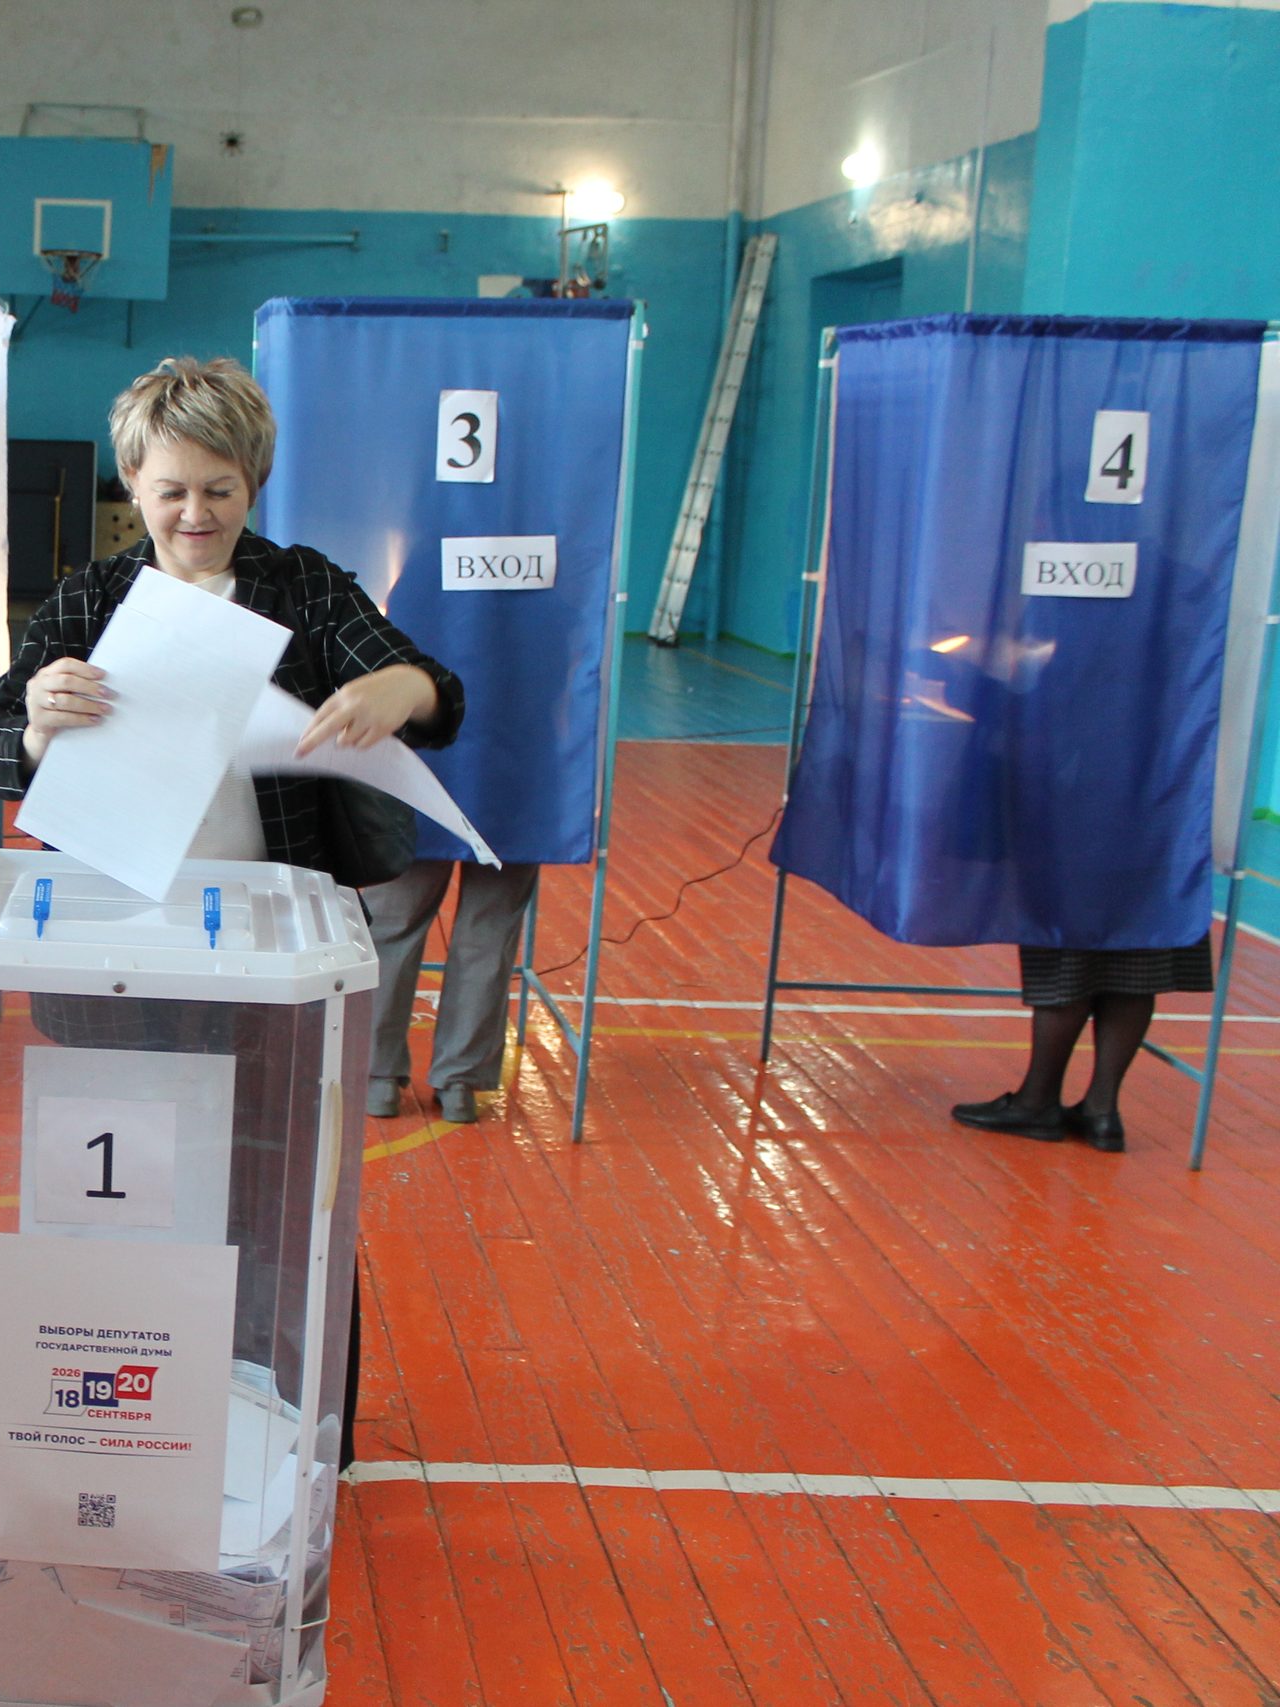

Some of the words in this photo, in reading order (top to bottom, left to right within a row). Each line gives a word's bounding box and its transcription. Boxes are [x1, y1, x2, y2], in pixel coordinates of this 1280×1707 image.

[446, 412, 482, 469] 3
[1100, 433, 1135, 490] 4
[455, 554, 544, 582] ВХОД
[1036, 560, 1125, 589] ВХОД
[86, 1132, 126, 1199] 1
[38, 1325, 94, 1337] ВЫБОРЫ
[96, 1329, 171, 1342] ДЕПУТАТОВ
[35, 1341, 138, 1355] ГОСУДАРСТВЕННОЙ
[140, 1347, 173, 1357] ДУМЫ
[51, 1367, 81, 1378] 2026
[55, 1389, 81, 1408] 18
[86, 1380, 113, 1400] 19
[118, 1372, 151, 1393] 20
[87, 1408, 153, 1422] СЕНТЯБРЯ
[8, 1431, 42, 1443] ТВОЙ
[44, 1433, 86, 1446] ГОЛОС
[99, 1437, 134, 1449] СИЛА
[136, 1439, 192, 1452] РОССИИ!
